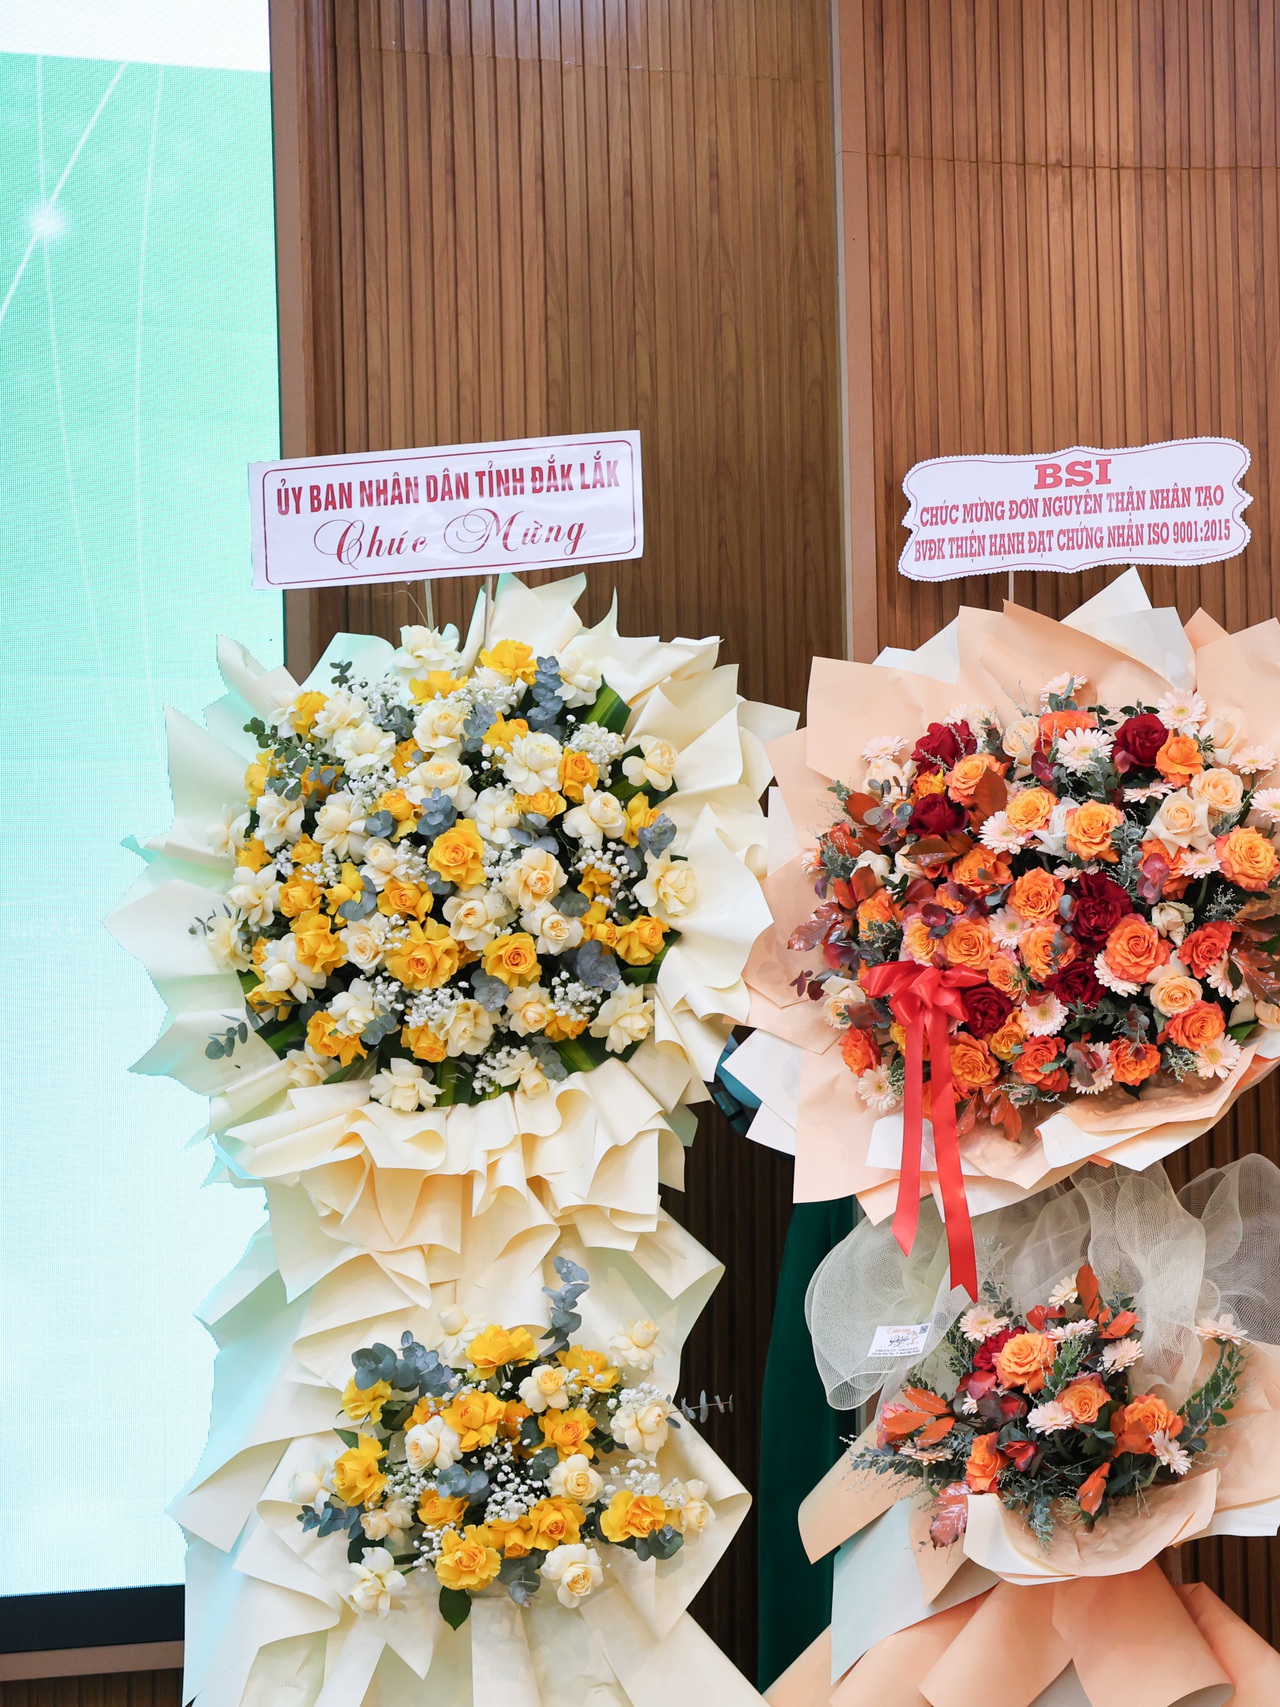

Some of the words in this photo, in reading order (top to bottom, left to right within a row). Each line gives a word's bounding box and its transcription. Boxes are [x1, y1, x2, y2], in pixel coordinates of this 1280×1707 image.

[277, 478, 303, 516] ỦY
[310, 482, 352, 513] BAN
[359, 471, 419, 507] NHÂN
[425, 467, 469, 503] DÂN
[475, 460, 525, 498] TỈNH
[530, 454, 573, 494] ĐẮK
[579, 450, 620, 490] LẮK
[1034, 459, 1110, 489] BSI
[920, 500, 959, 527] CHÚC
[962, 497, 1006, 522] MỪNG
[1008, 495, 1039, 521] ĐƠN
[1042, 489, 1103, 517] NGUYÊN
[1106, 485, 1147, 516] THẬN
[1149, 482, 1192, 510] NHÂN
[1194, 484, 1225, 511] TẠO
[313, 518, 427, 570] Chúc
[443, 507, 587, 556] Mừng
[914, 537, 946, 563] BVĐK
[948, 530, 986, 563] THIỆN
[989, 532, 1025, 561] HẠNH
[1027, 530, 1054, 558] ĐẠT
[1057, 521, 1104, 551] CHỨNG
[1107, 518, 1145, 552] NHẬN
[1147, 521, 1170, 545] ISO
[1173, 518, 1231, 544] 9001:2015
